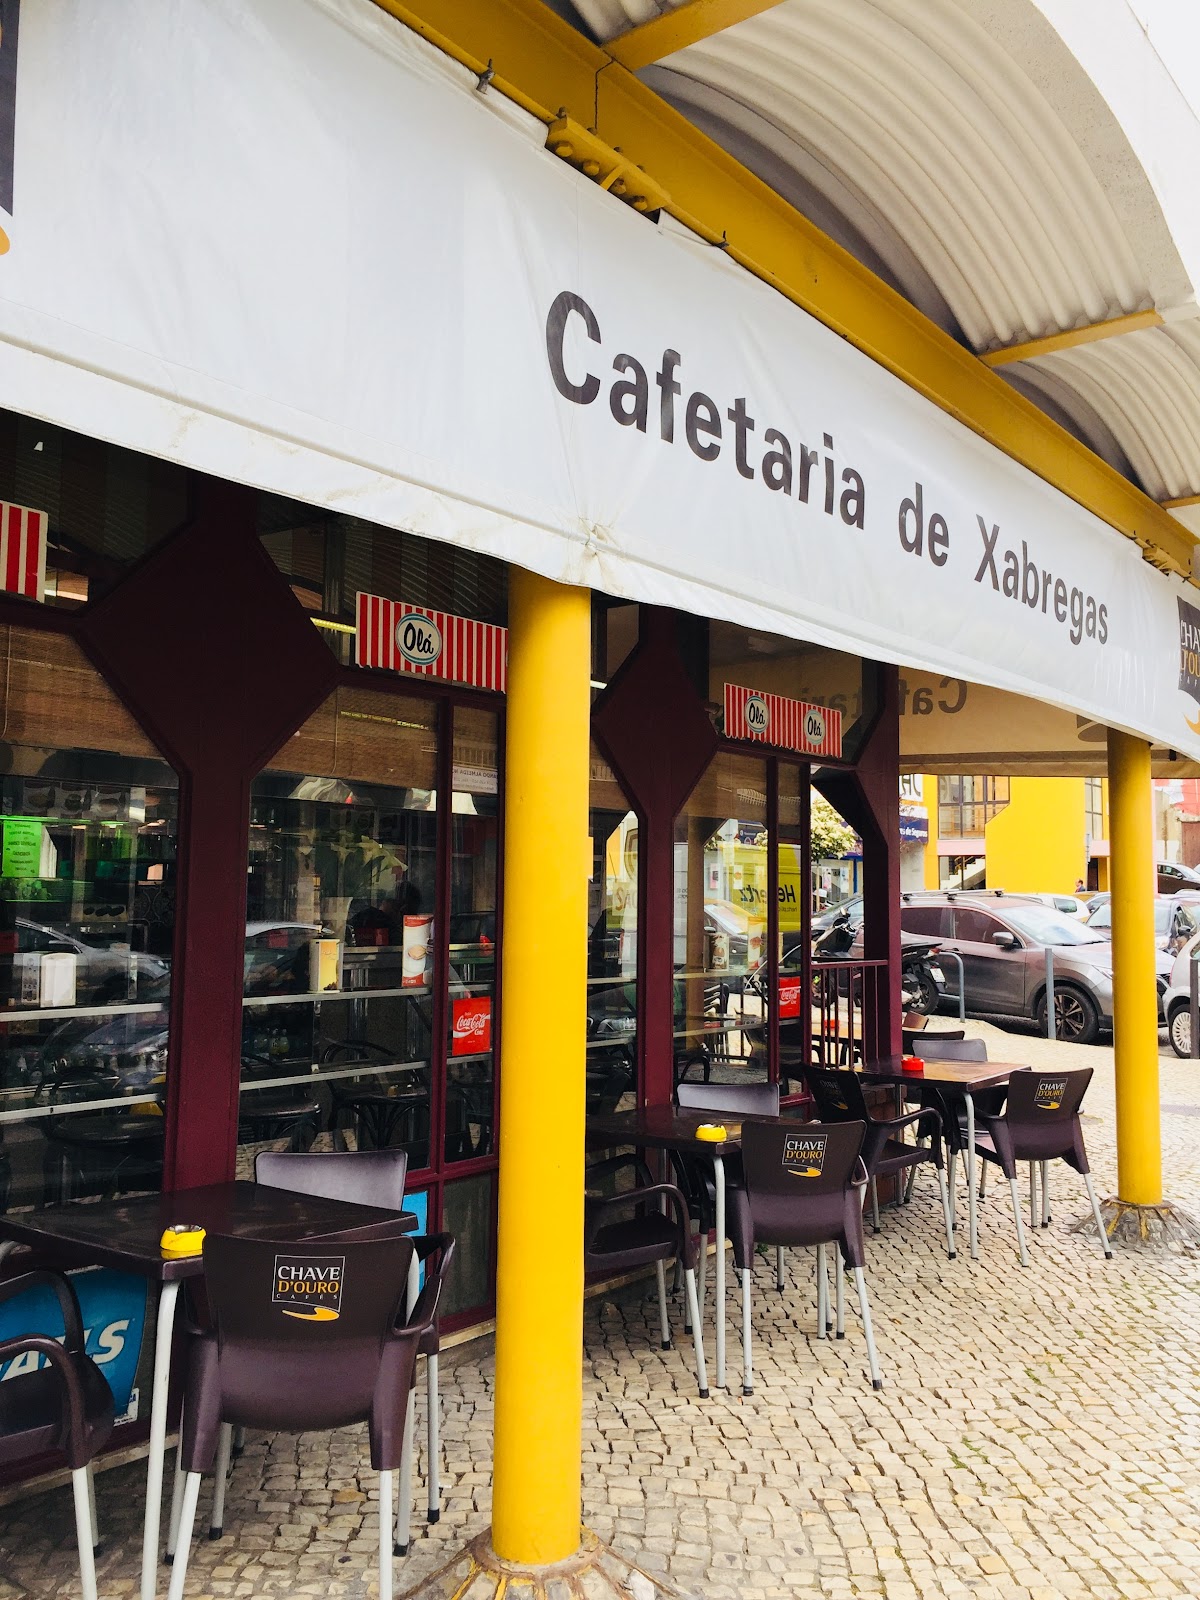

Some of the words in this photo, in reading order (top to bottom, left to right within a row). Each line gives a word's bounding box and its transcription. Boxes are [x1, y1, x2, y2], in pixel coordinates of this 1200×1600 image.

[546, 291, 865, 530] Cafetaria
[898, 482, 950, 567] de
[974, 514, 1109, 646] Xabregas
[404, 622, 434, 654] Olá
[748, 702, 766, 725] Olá
[807, 715, 822, 737] Olá
[456, 1013, 486, 1031] Coca-Cola
[1040, 1082, 1067, 1090] CHAVE
[786, 1140, 825, 1151] CHAVE
[786, 1150, 823, 1159] D'OURO
[277, 1265, 341, 1281] CHAVE
[278, 1280, 340, 1294] D'OURO
